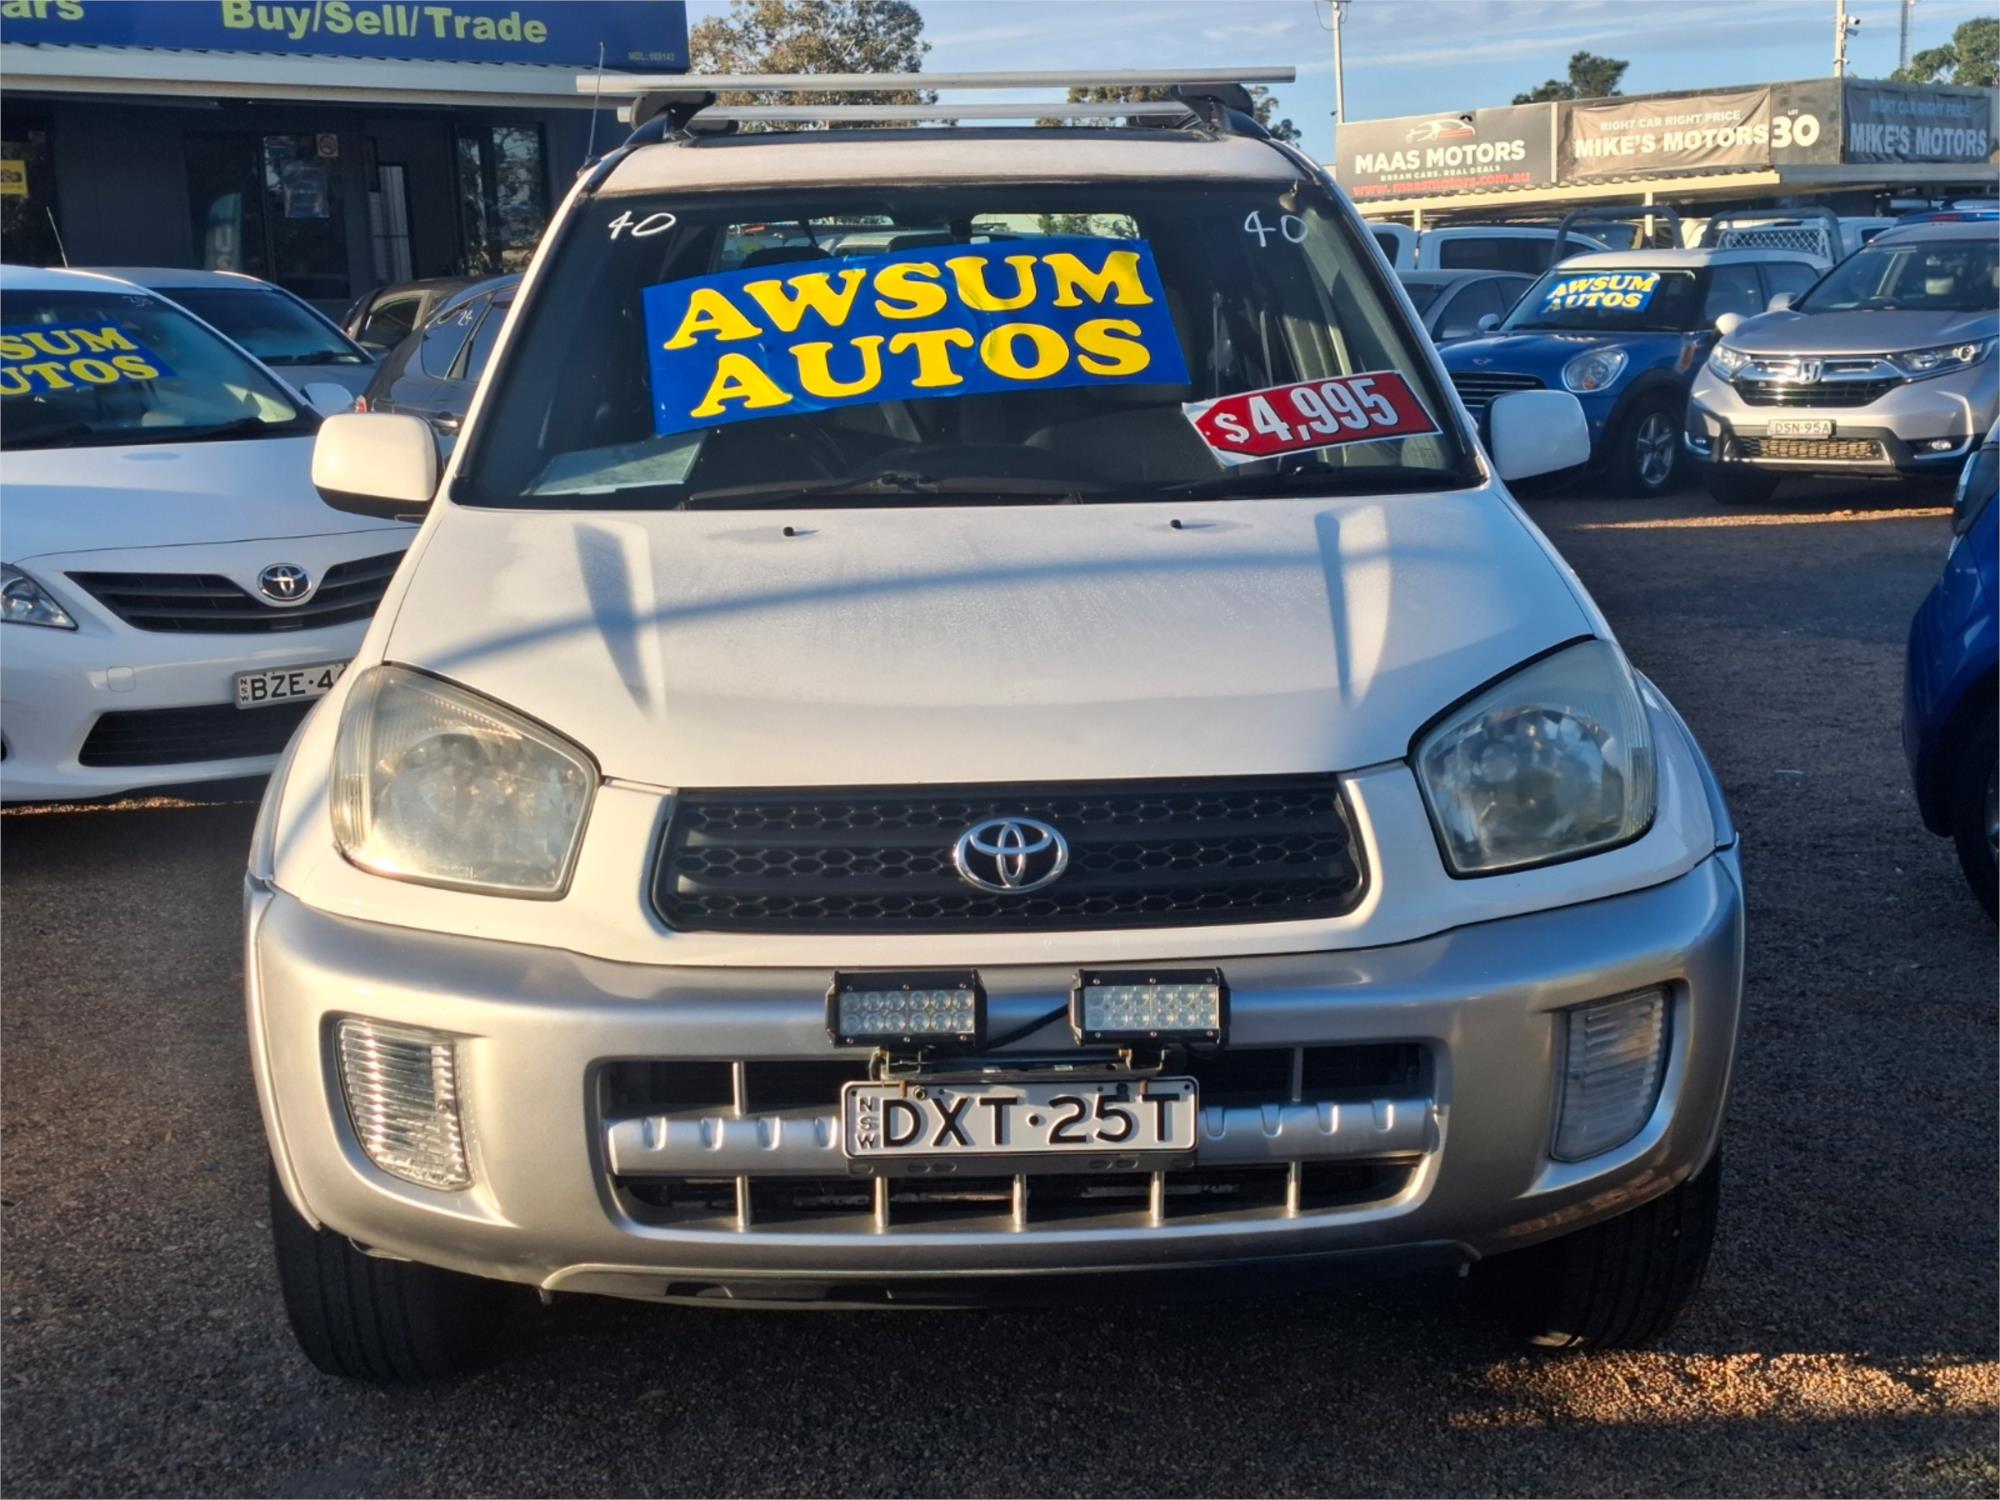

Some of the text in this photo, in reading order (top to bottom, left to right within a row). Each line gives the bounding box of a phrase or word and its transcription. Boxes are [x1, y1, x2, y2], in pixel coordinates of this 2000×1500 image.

[221, 0, 548, 43] Buy/Sell/Trade
[1601, 111, 1741, 131] RIGHT CAR RIGHT PRICE
[1771, 114, 1820, 148] 30
[1355, 140, 1526, 174] MAAS MOTORS
[1574, 124, 1770, 158] MIKE'S MOTORS
[1850, 123, 1988, 157] MIKE'S MOTORS
[1380, 173, 1411, 182] DREAM
[1443, 167, 1468, 176] REAL
[1470, 165, 1501, 174] DEALS
[608, 210, 676, 240] 40
[1244, 210, 1308, 247] 40
[664, 251, 1154, 350] AWSUM
[1541, 292, 1643, 313] AUTOS
[1546, 274, 1660, 299] AWSUM
[1, 327, 139, 360] SUM
[690, 319, 1151, 418] AUTOS
[1214, 378, 1399, 443] $4,995
[240, 679, 250, 701] NSW
[250, 662, 347, 701] BZE·4
[856, 1096, 878, 1149] NSW
